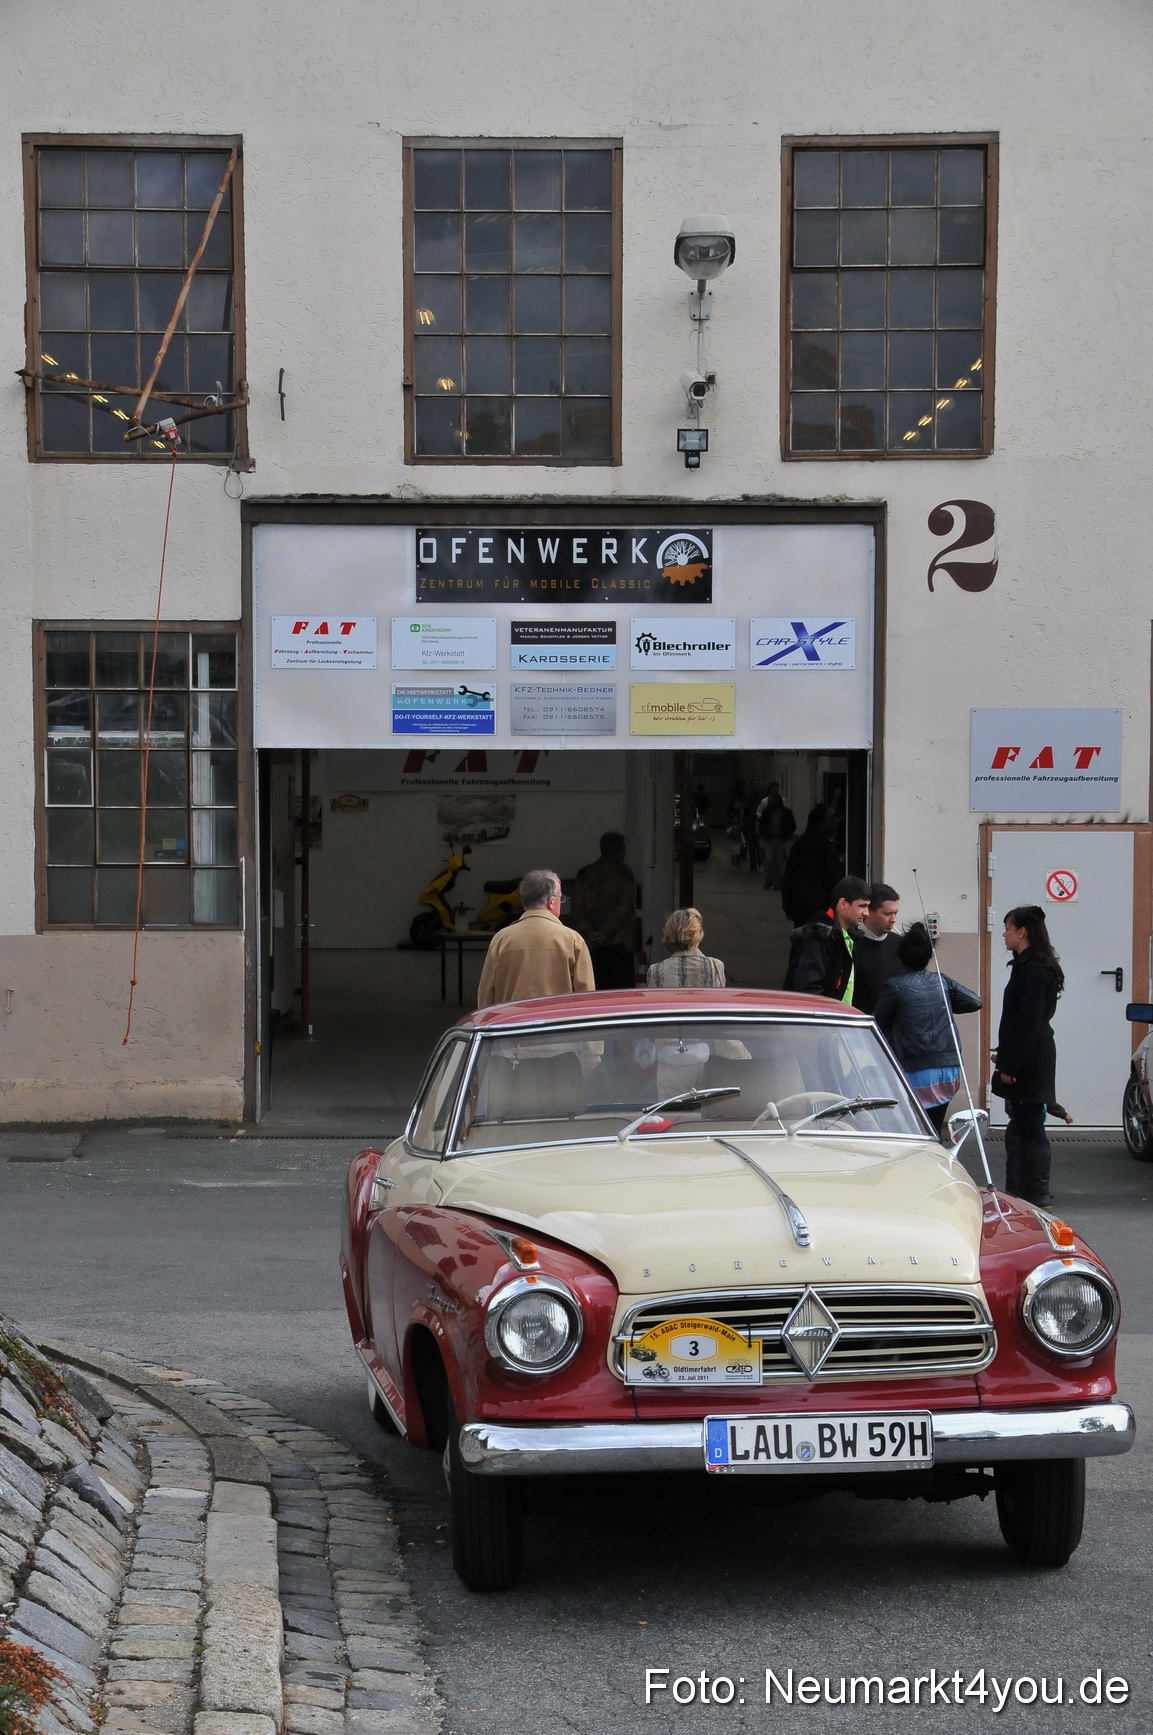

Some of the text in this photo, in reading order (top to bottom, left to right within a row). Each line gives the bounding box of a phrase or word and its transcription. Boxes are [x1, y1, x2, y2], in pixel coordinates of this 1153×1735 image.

[419, 537, 649, 564] OFENWERK
[927, 499, 999, 593] 2
[420, 576, 650, 589] ZENTRUM FÜR MOBILE CLASSIC
[291, 621, 358, 635] FAT
[653, 642, 731, 650] Blechroller
[518, 654, 610, 663] KAROSSERIE
[990, 746, 1102, 769] FAT
[642, 1256, 960, 1278] BORGWARD
[650, 1322, 736, 1342] 15. ADAC Steigerwald-Main
[689, 1340, 699, 1356] 3
[714, 1421, 928, 1460] D LAU BW 59H
